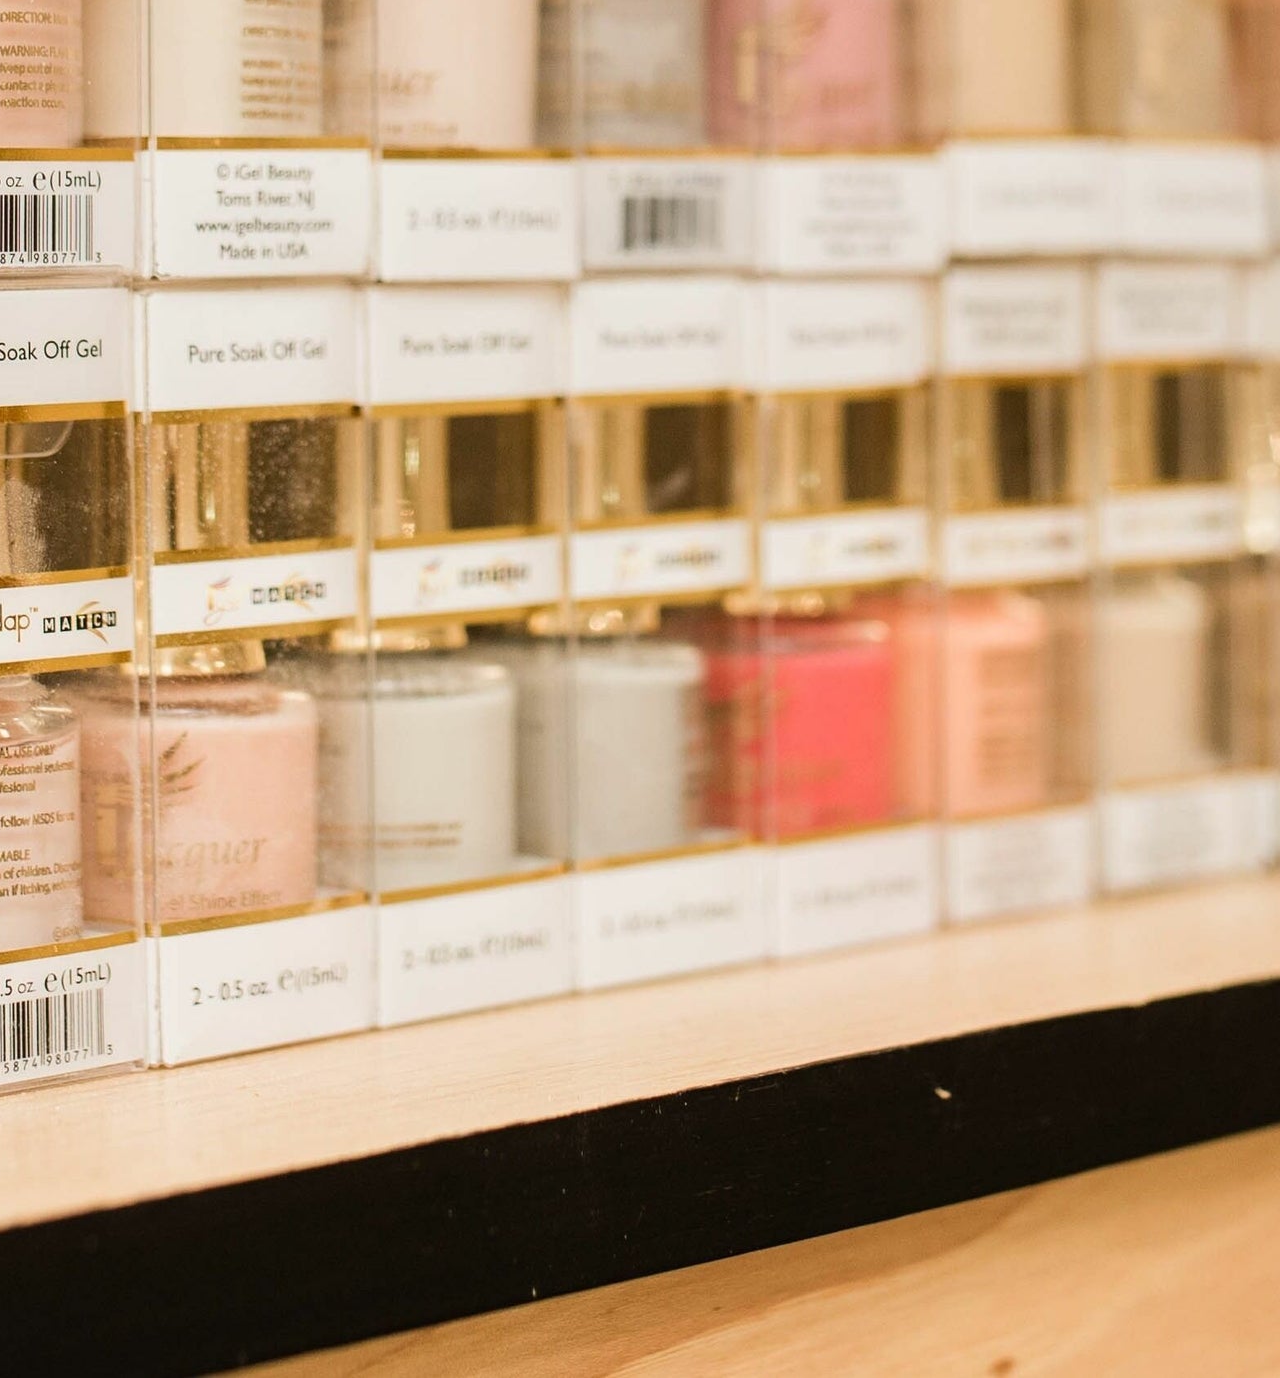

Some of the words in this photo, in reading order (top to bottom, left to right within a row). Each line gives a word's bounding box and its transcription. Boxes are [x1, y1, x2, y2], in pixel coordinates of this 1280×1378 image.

[0, 45, 48, 58] WARNING:
[216, 190, 251, 207] Toms
[33, 253, 76, 264] 98077
[96, 252, 102, 263] 3
[220, 243, 256, 260] Made
[278, 242, 309, 259] USA
[44, 340, 70, 360] Off
[76, 338, 102, 358] Gel
[188, 344, 225, 364] Pure
[230, 342, 266, 362] Soak
[273, 341, 296, 360] Off
[42, 610, 117, 634] MATCH
[0, 814, 31, 829] follow
[191, 986, 202, 1006] 2
[220, 979, 243, 1001] 0.5
[46, 1048, 88, 1066] 98077
